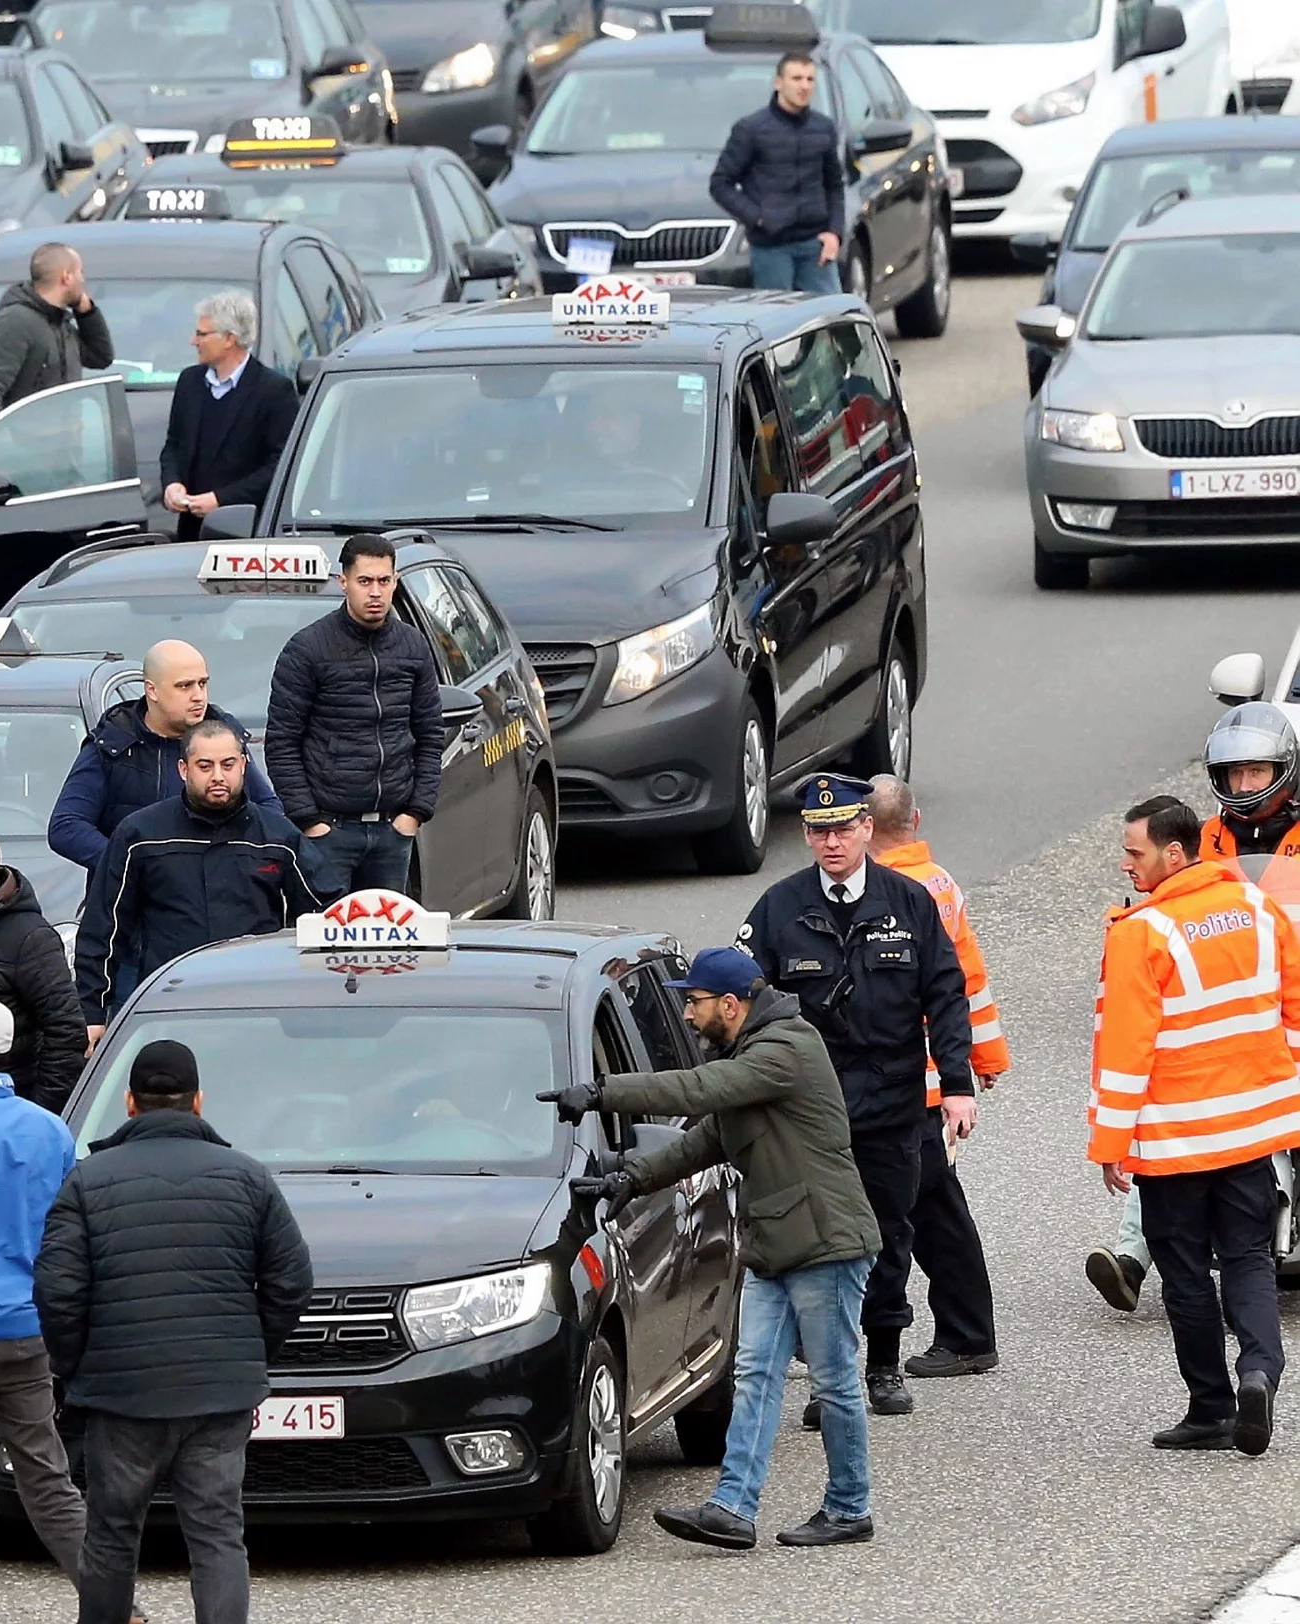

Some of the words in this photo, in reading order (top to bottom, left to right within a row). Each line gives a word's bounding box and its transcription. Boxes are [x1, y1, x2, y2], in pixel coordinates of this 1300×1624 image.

[252, 116, 311, 140] TAXI
[146, 189, 205, 211] TAXI
[578, 281, 644, 303] TAXI
[563, 303, 659, 316] UNITAX.BE
[226, 556, 300, 573] TAXI
[324, 895, 414, 927] TAXI
[324, 926, 419, 942] UNITAX
[866, 931, 888, 942] Police
[889, 930, 912, 940] Politie
[1183, 909, 1252, 942] Politie
